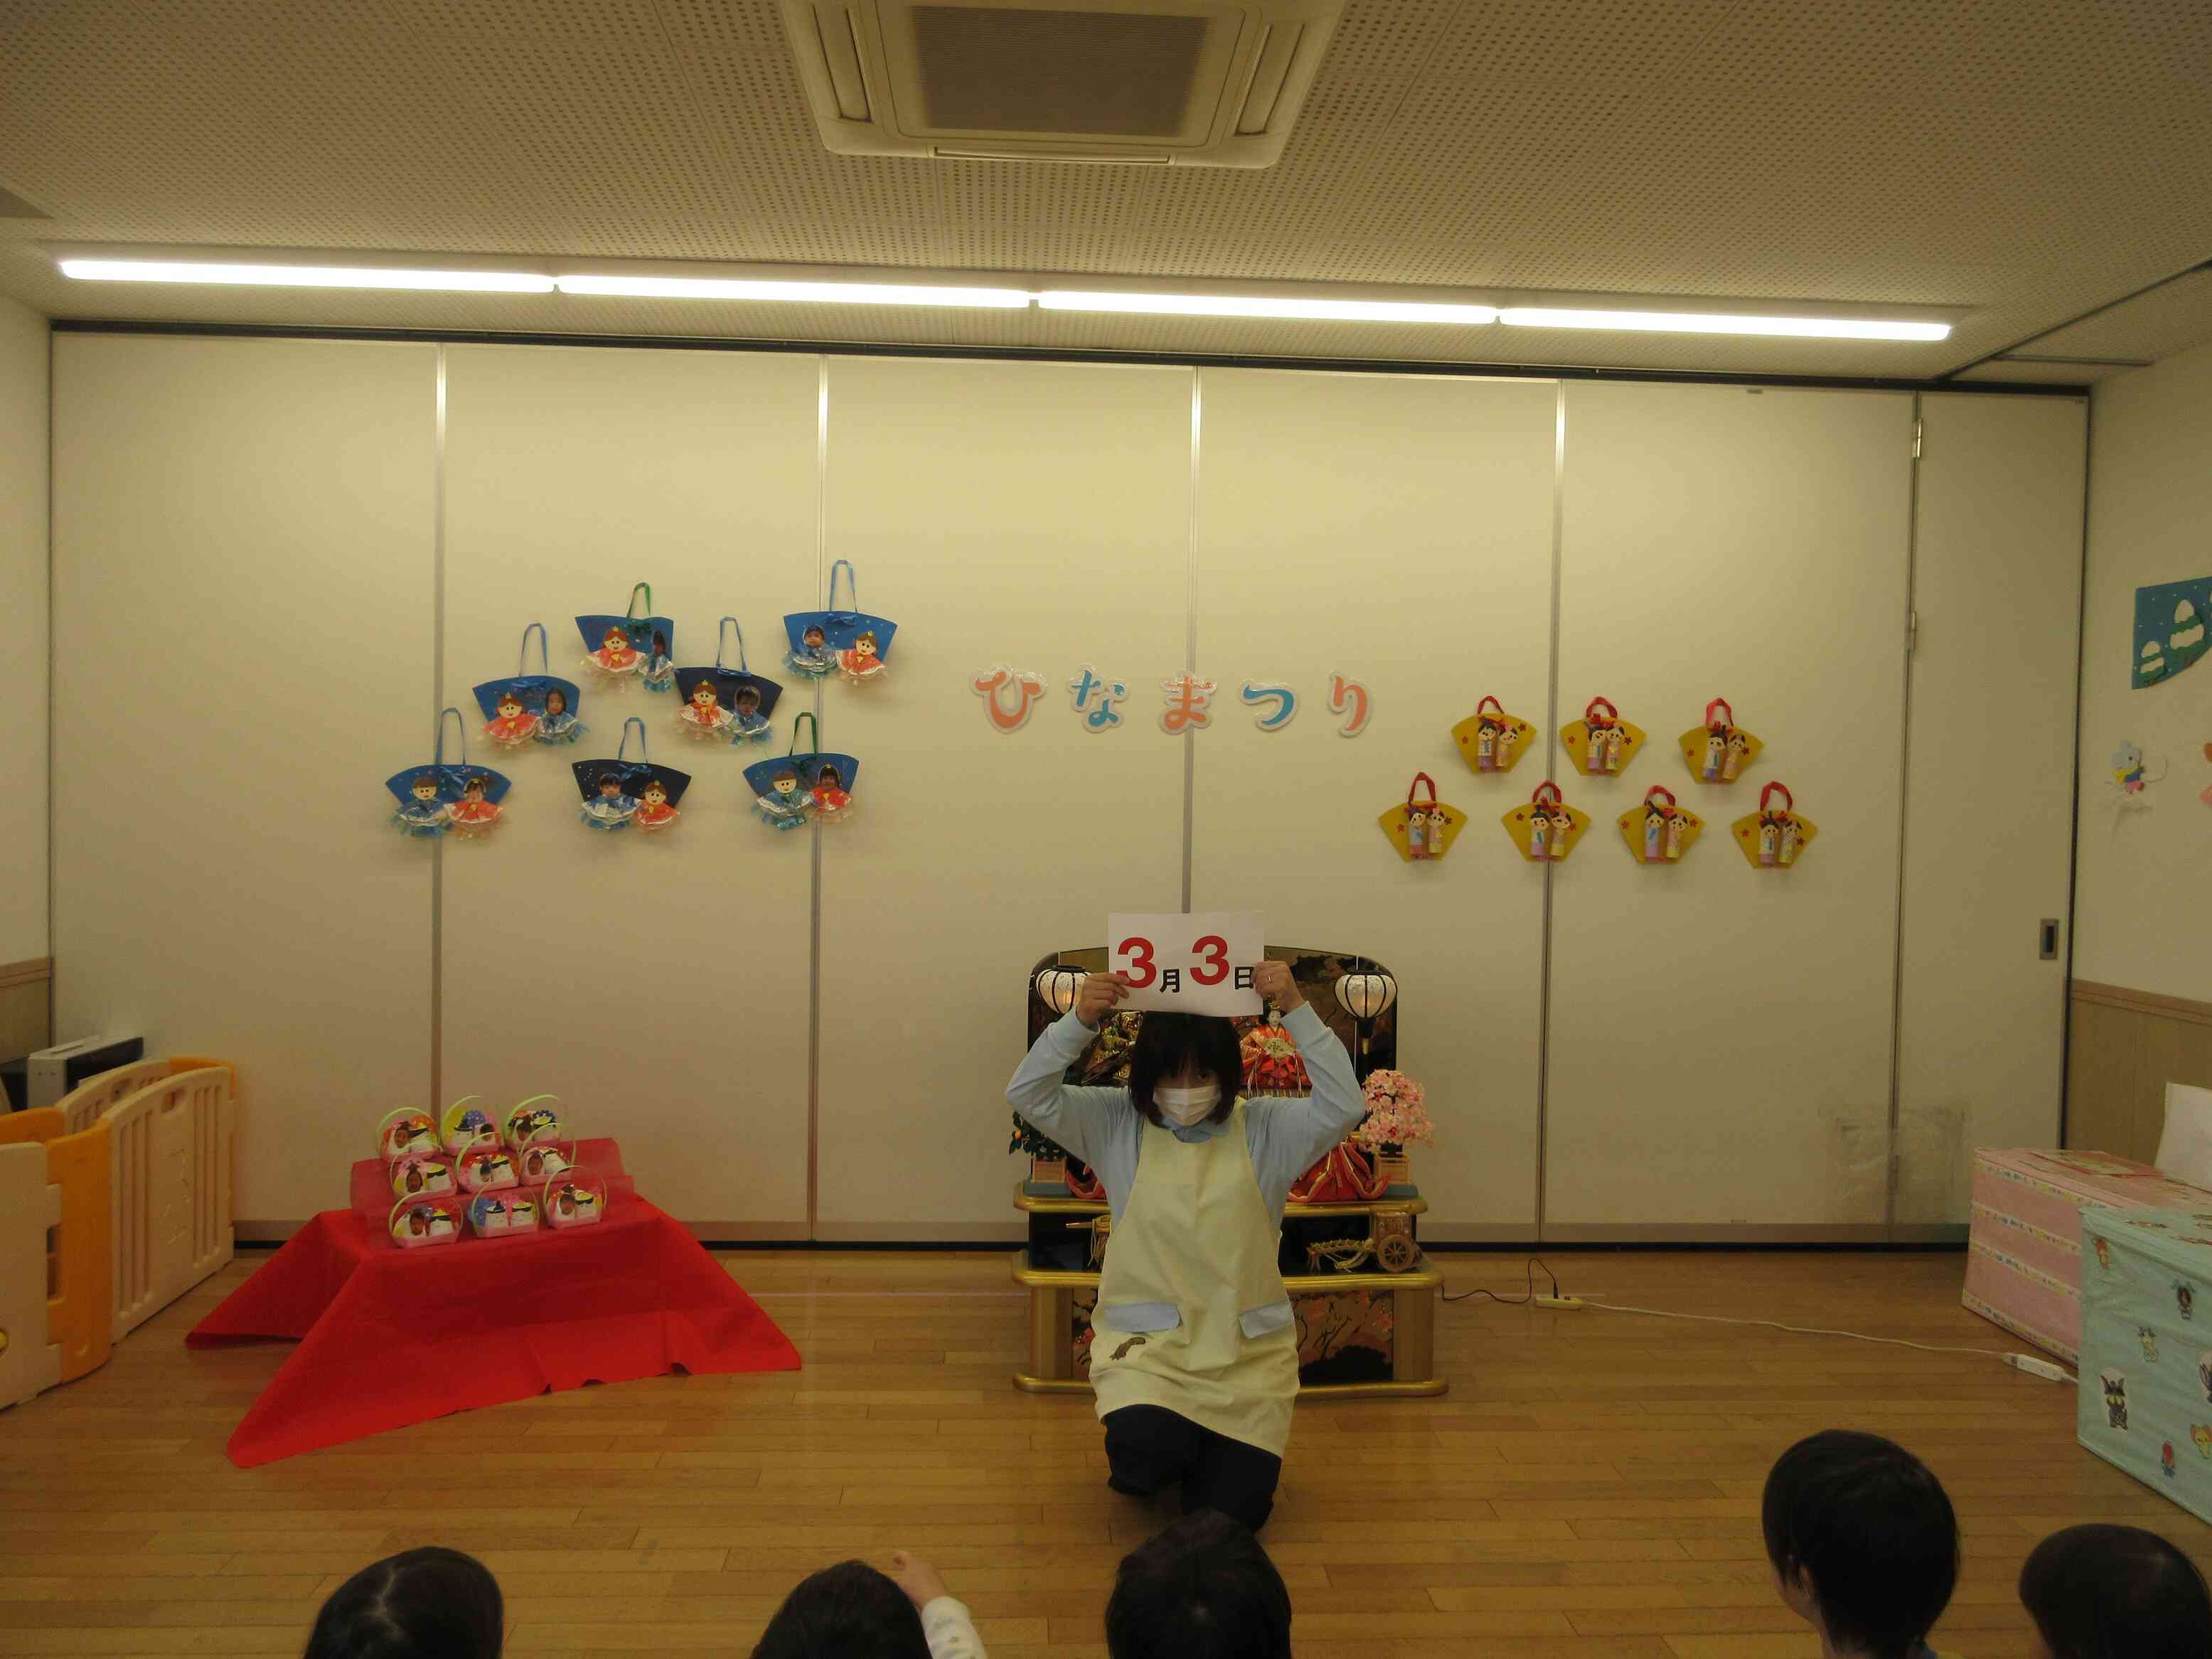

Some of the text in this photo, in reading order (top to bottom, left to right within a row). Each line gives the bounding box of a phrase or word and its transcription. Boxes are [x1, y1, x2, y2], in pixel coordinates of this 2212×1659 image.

[974, 669, 1368, 732] ひなまつり
[1116, 934, 1255, 993] 3月3日
